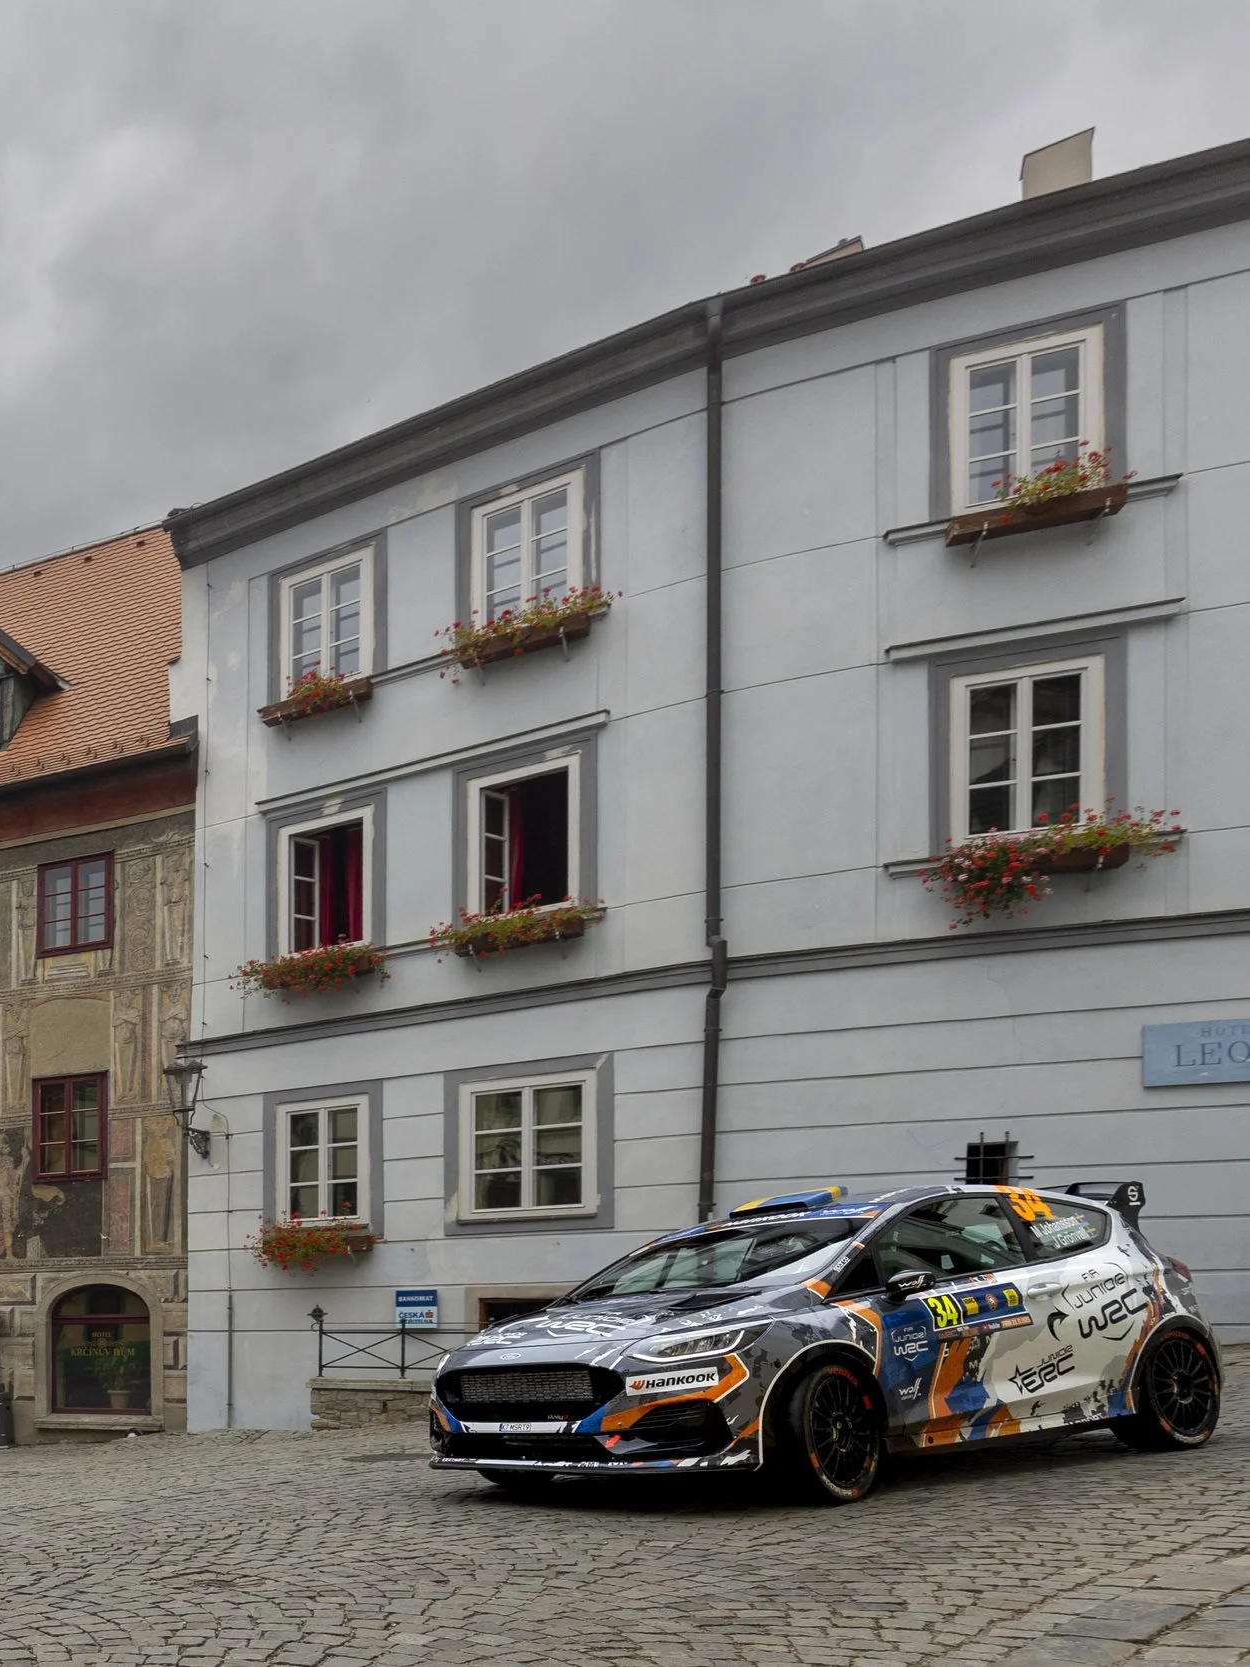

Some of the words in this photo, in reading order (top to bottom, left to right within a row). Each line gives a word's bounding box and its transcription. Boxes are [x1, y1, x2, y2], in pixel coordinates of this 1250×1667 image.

[1030, 1225, 1042, 1238] M
[1039, 1215, 1079, 1236] Johansson
[1052, 1235, 1060, 1249] J
[1081, 1269, 1099, 1282] FIA
[1074, 1272, 1125, 1309] JUNIOR
[927, 1295, 959, 1328] 34
[1078, 1288, 1149, 1339] WRC
[535, 1320, 626, 1338] WRC
[894, 1332, 926, 1343] JUNIOR
[893, 1340, 929, 1356] WRC
[1037, 1344, 1073, 1368] JUNIOR
[1021, 1353, 1075, 1393] ERC
